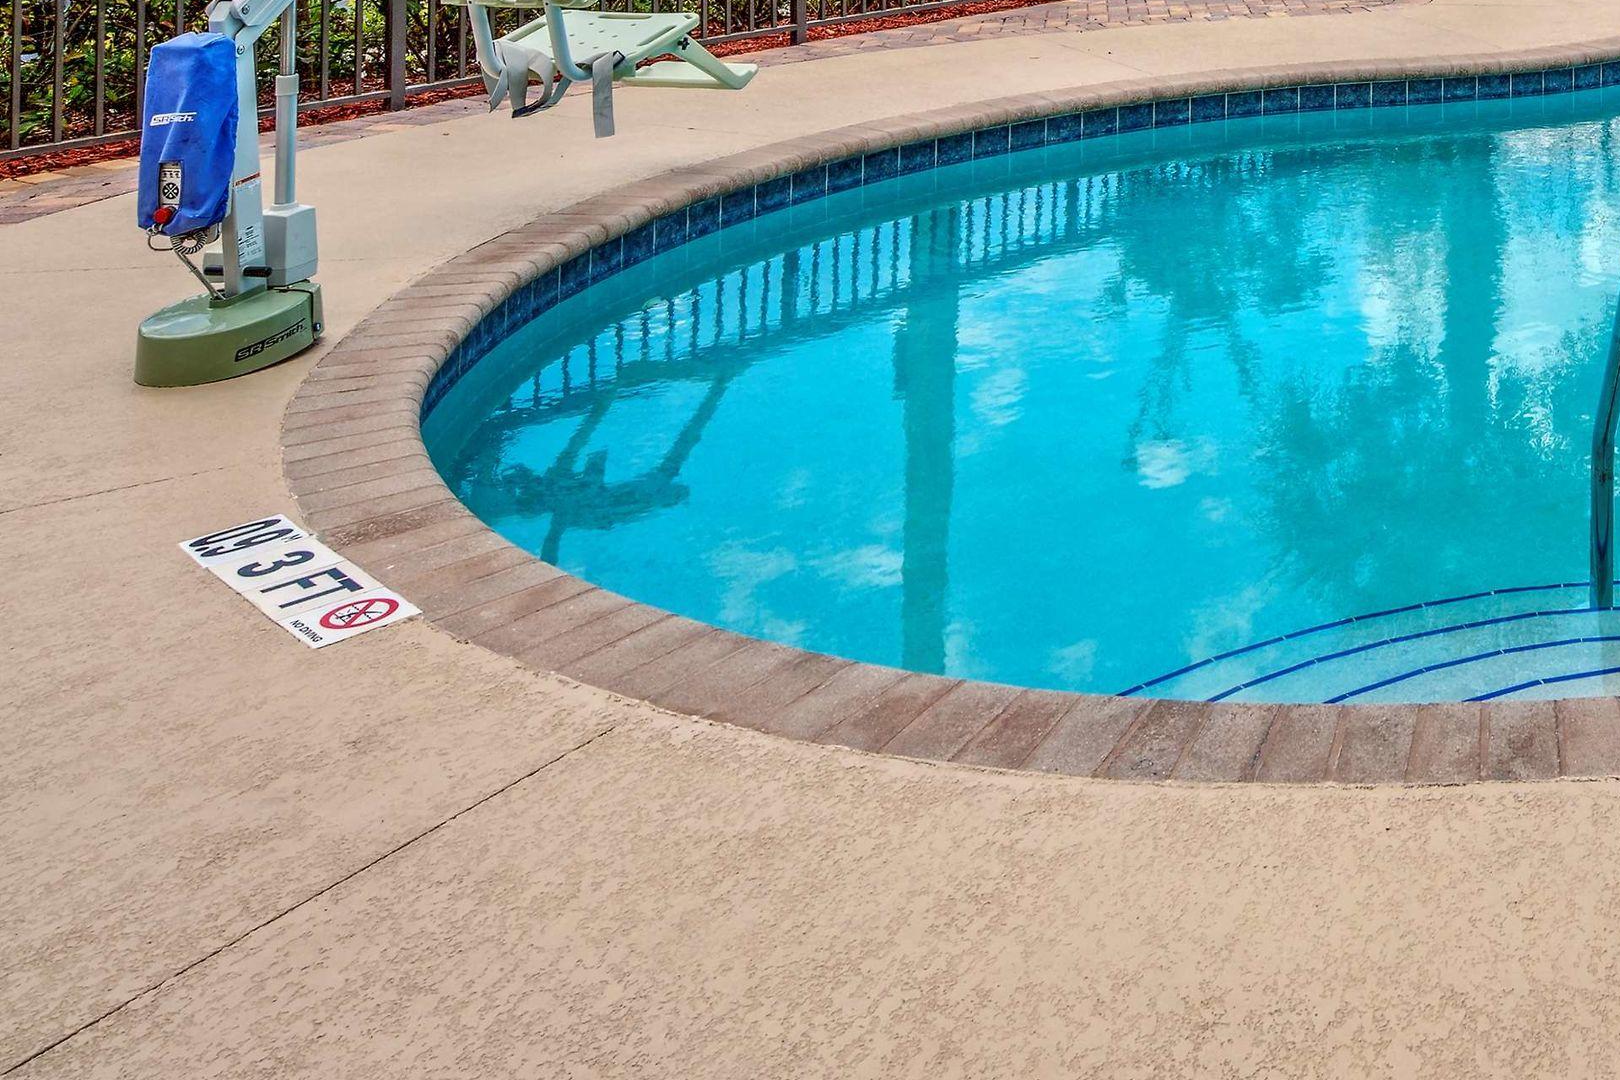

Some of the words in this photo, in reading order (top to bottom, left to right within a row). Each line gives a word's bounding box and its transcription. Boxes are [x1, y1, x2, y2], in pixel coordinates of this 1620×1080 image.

[236, 550, 316, 578] 3
[259, 566, 365, 609] FT
[290, 619, 305, 629] NO
[299, 626, 324, 643] DIVING
